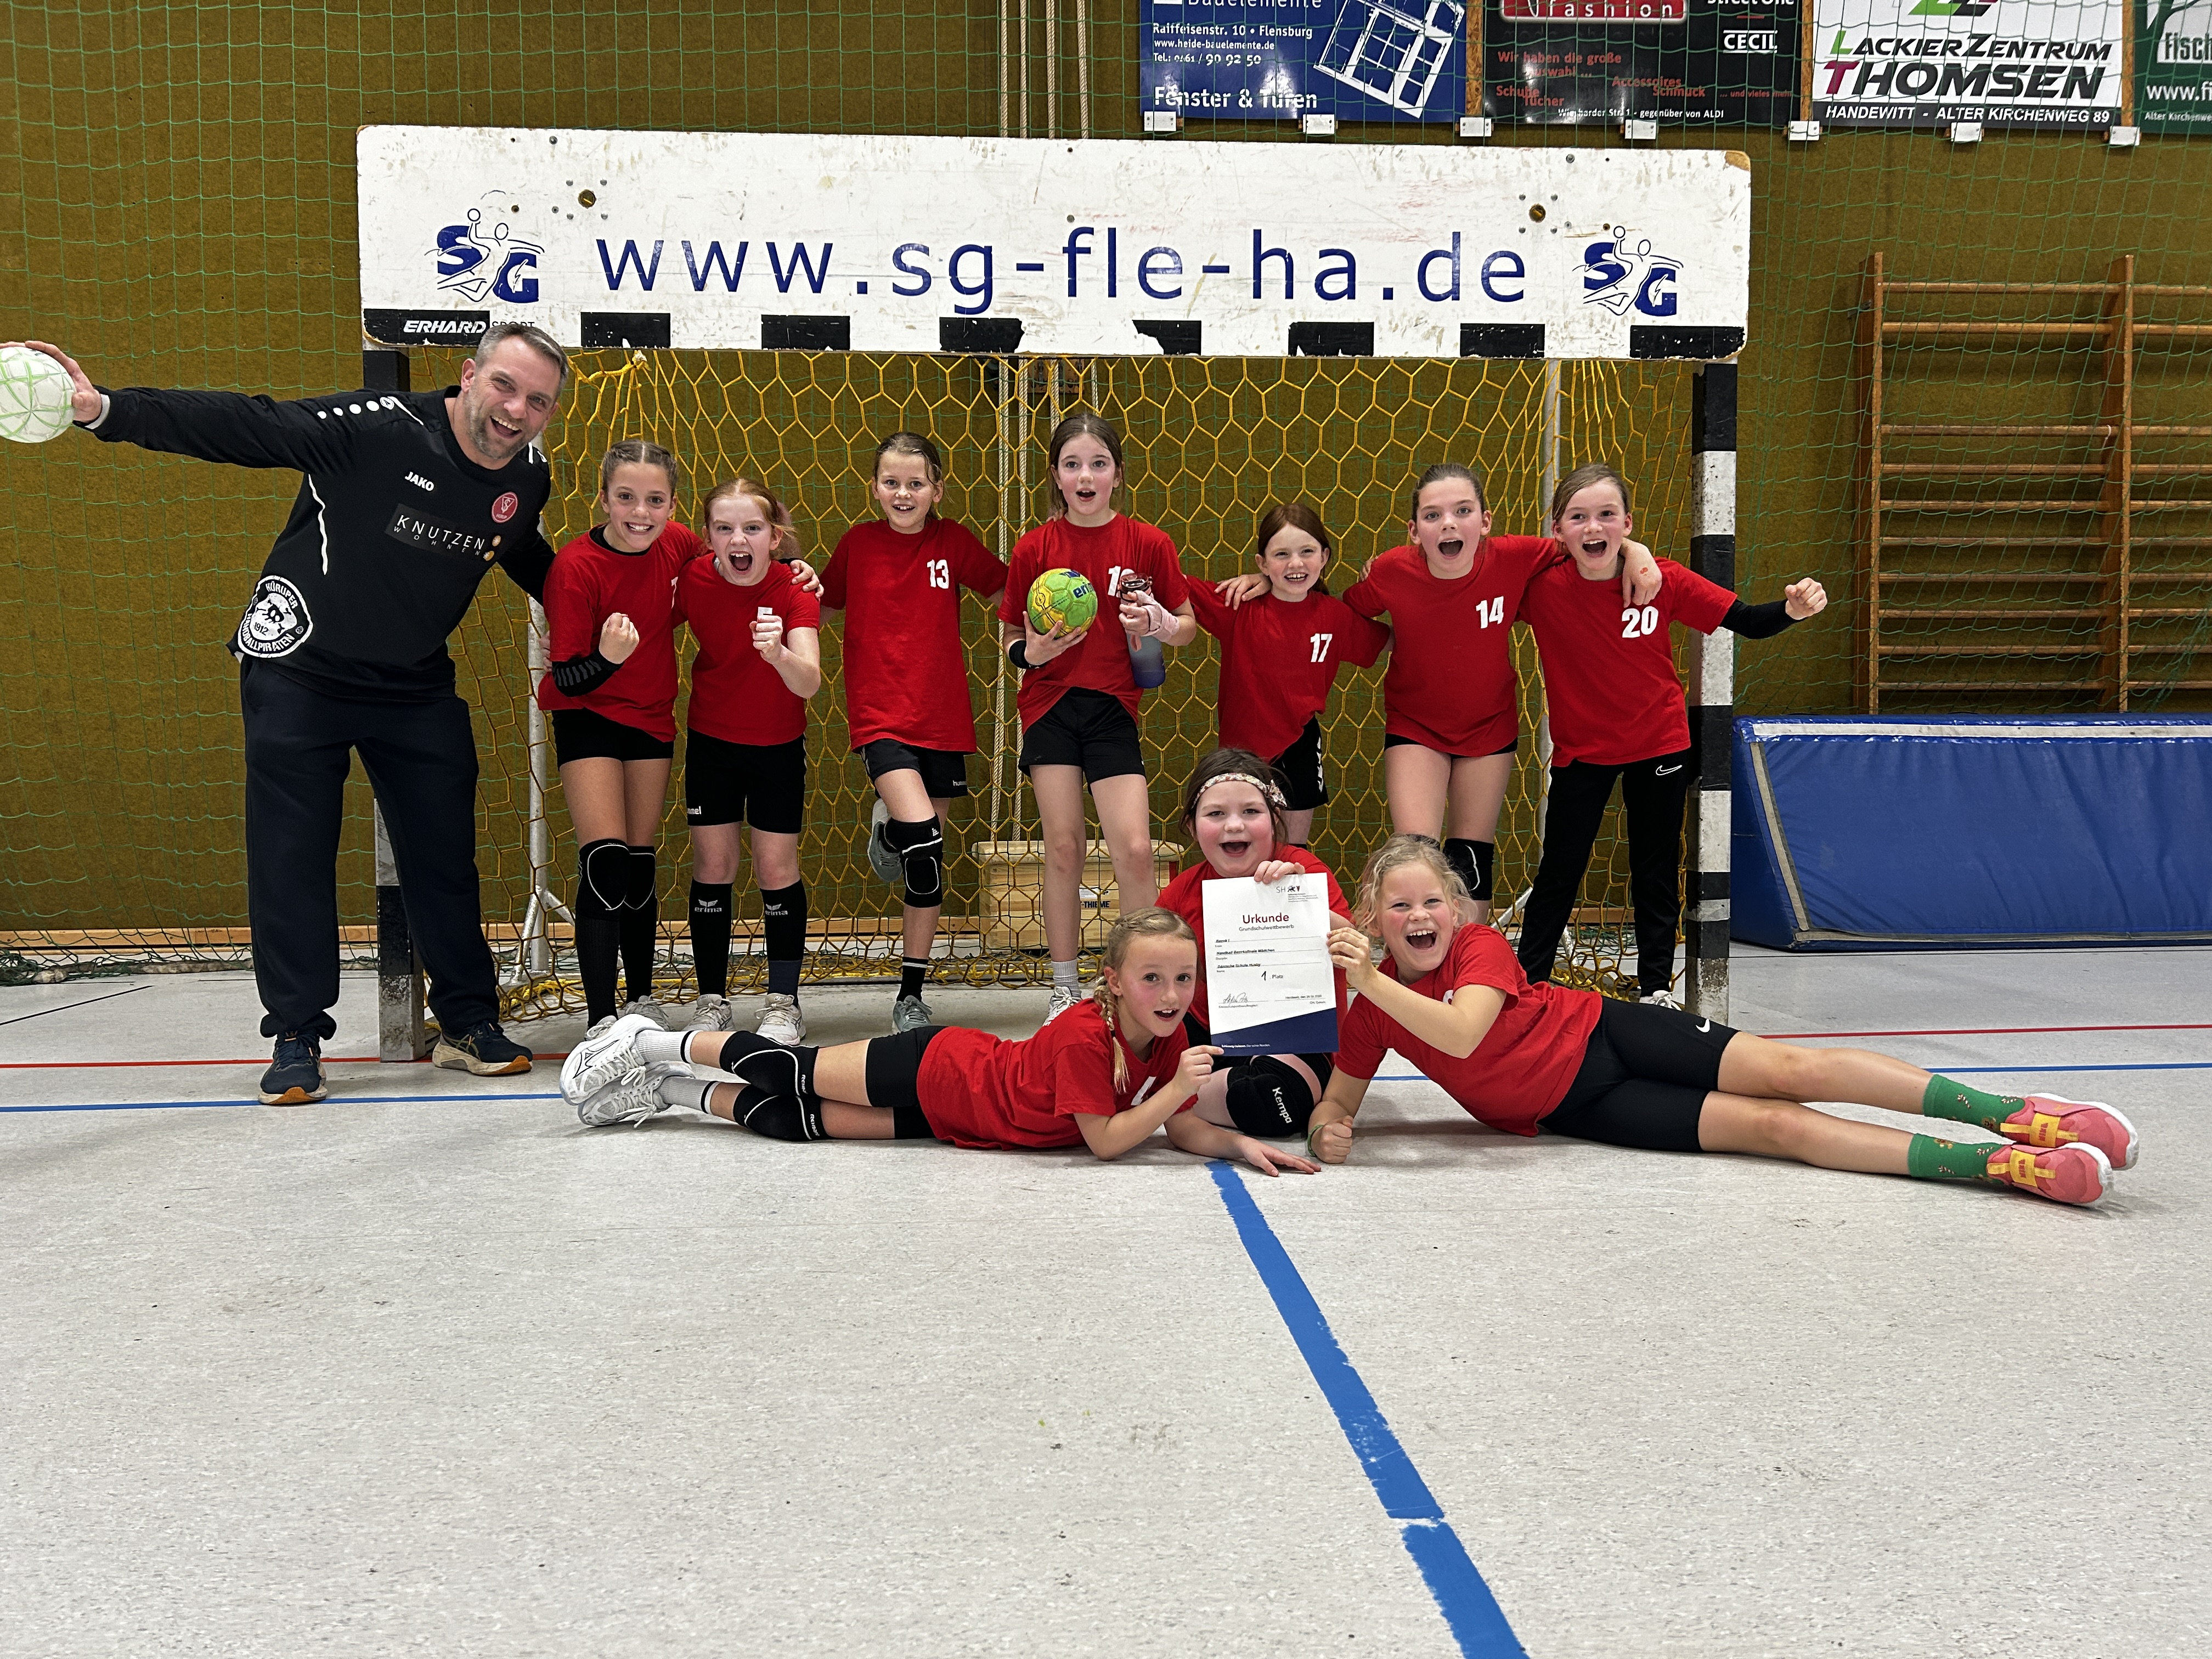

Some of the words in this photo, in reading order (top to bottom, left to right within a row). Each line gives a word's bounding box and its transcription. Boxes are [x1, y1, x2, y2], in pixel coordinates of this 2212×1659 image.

[1549, 0, 1672, 17] fashion
[1153, 23, 1228, 35] Raiffeisenstr.
[1233, 25, 1245, 35] 10
[1259, 25, 1312, 39] Flensburg
[1154, 39, 1275, 49] www.heide-bauelemente.de
[1724, 34, 1778, 50] CECIL
[1154, 53, 1171, 62] Tel.:
[1498, 52, 1519, 63] Wir
[1523, 52, 1560, 64] haben
[1565, 53, 1583, 64] die
[1587, 53, 1622, 66] große
[1824, 60, 2106, 99] THOMSEN
[1155, 86, 1231, 107] Fenster
[1239, 89, 1253, 108] &
[1496, 86, 1539, 97] Schuhe
[1652, 86, 1706, 97] Schmuck
[1640, 109, 1683, 118] gegenüber
[1826, 105, 1915, 120] HANDEWITT
[1936, 108, 1984, 120] ALTER
[1988, 108, 2090, 123] KIRCHENWEG
[2093, 111, 2110, 123] 89
[596, 227, 1525, 315] www.sg-fle-ha.de
[403, 320, 487, 333] ERHARD
[405, 471, 435, 492] JAKO
[393, 526, 480, 556] WOHNEN
[397, 515, 485, 550] KNUTZEN
[927, 560, 949, 589] 13
[1476, 596, 1504, 629] 14
[255, 622, 269, 636] 1912
[1622, 606, 1659, 638] 20
[242, 613, 295, 652] HANDBALLPIRATEN
[1310, 633, 1333, 662] 17
[1080, 900, 1110, 909] -THIEME
[1243, 912, 1289, 924] Urkunde
[1272, 1087, 1292, 1124] Kempa
